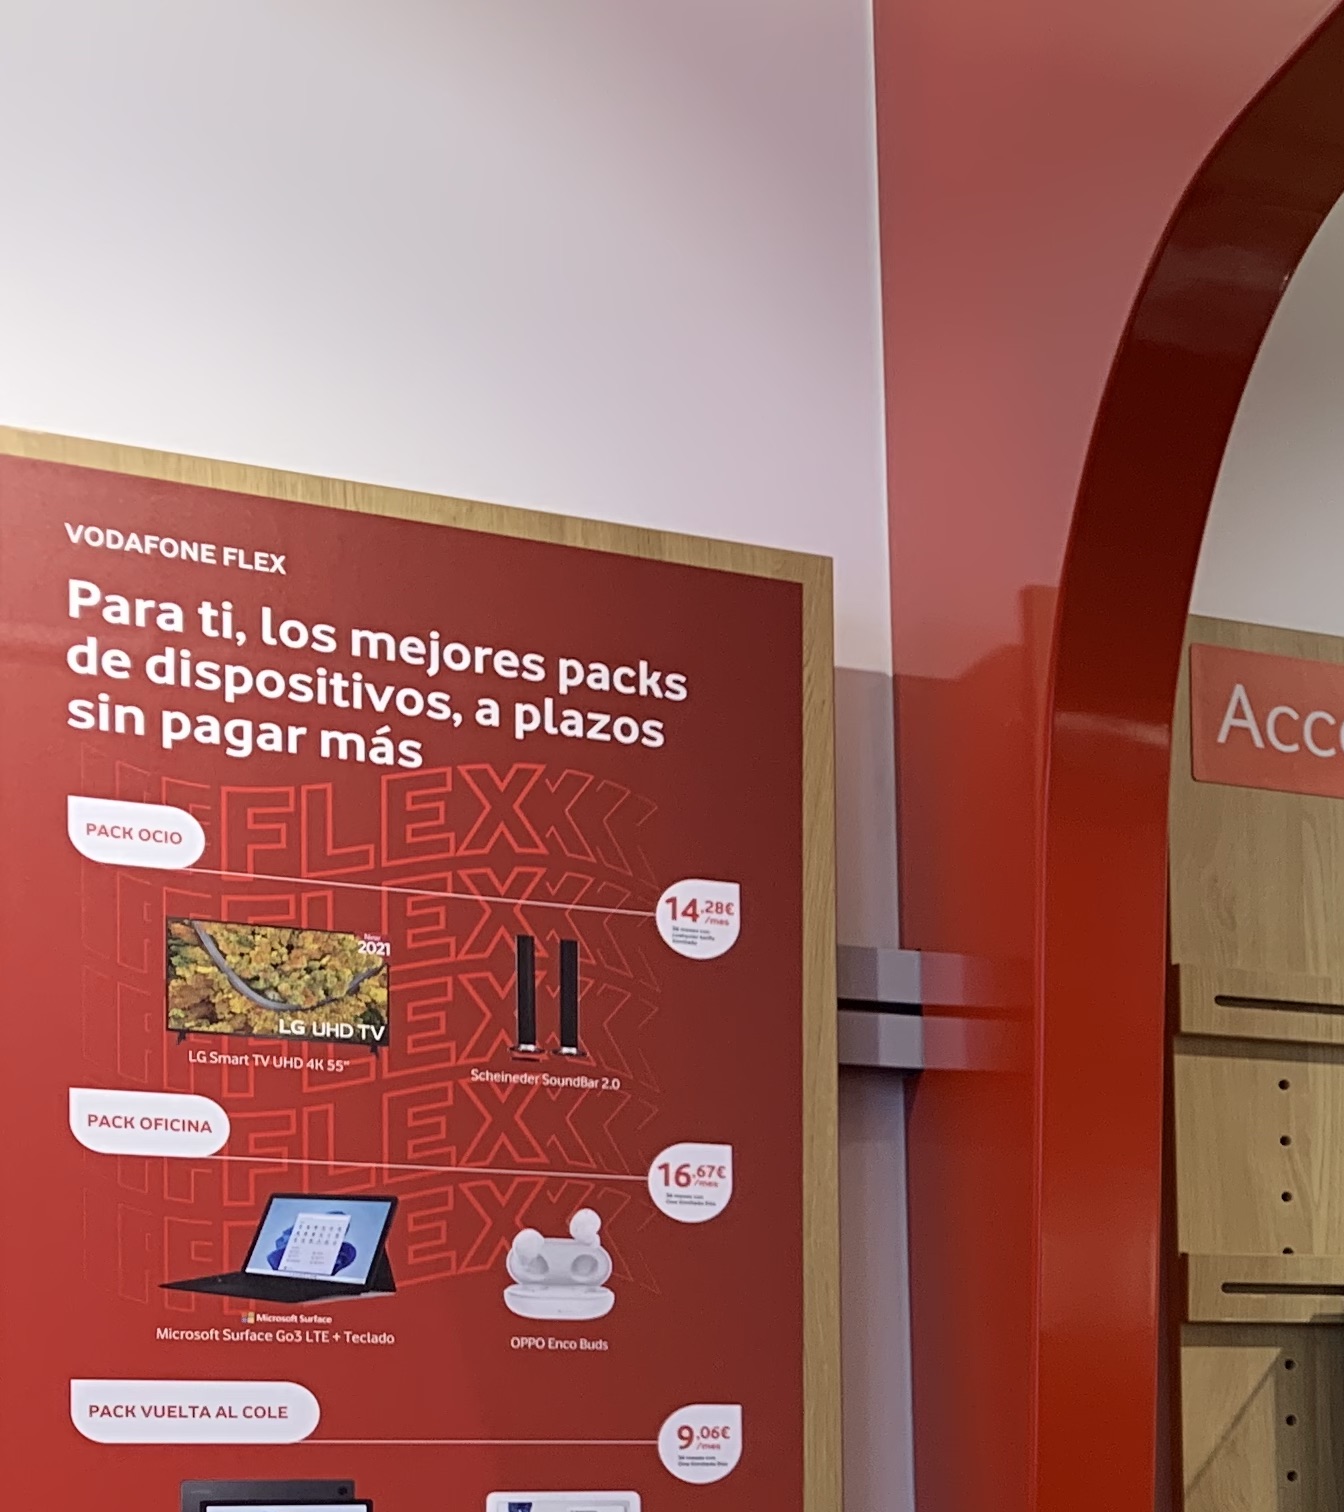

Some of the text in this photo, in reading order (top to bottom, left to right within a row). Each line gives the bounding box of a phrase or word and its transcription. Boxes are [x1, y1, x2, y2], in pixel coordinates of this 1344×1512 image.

[64, 522, 287, 575] VODAFONE FLEX
[68, 578, 688, 701] Para ti, los mejores packs
[66, 636, 665, 748] de dispositivos, a plazos
[67, 692, 423, 769] sin pagar más
[86, 823, 182, 845] PACK OCIO
[357, 940, 391, 956] 2021
[279, 1020, 385, 1041] LG UHD TV
[189, 1051, 350, 1072] LG Smart TV UHD 4K 55"
[471, 1068, 621, 1090] Scheineder SoundBar 2.0
[87, 1114, 212, 1134] PACK OFICINA
[256, 1313, 332, 1325] Microsoft Surface
[156, 1327, 395, 1345] Microsoft Surface Go3 LTE Teclado
[510, 1337, 608, 1350] OPPO Enco Buds
[89, 1405, 288, 1420] PACK VUELTA AL COLE
